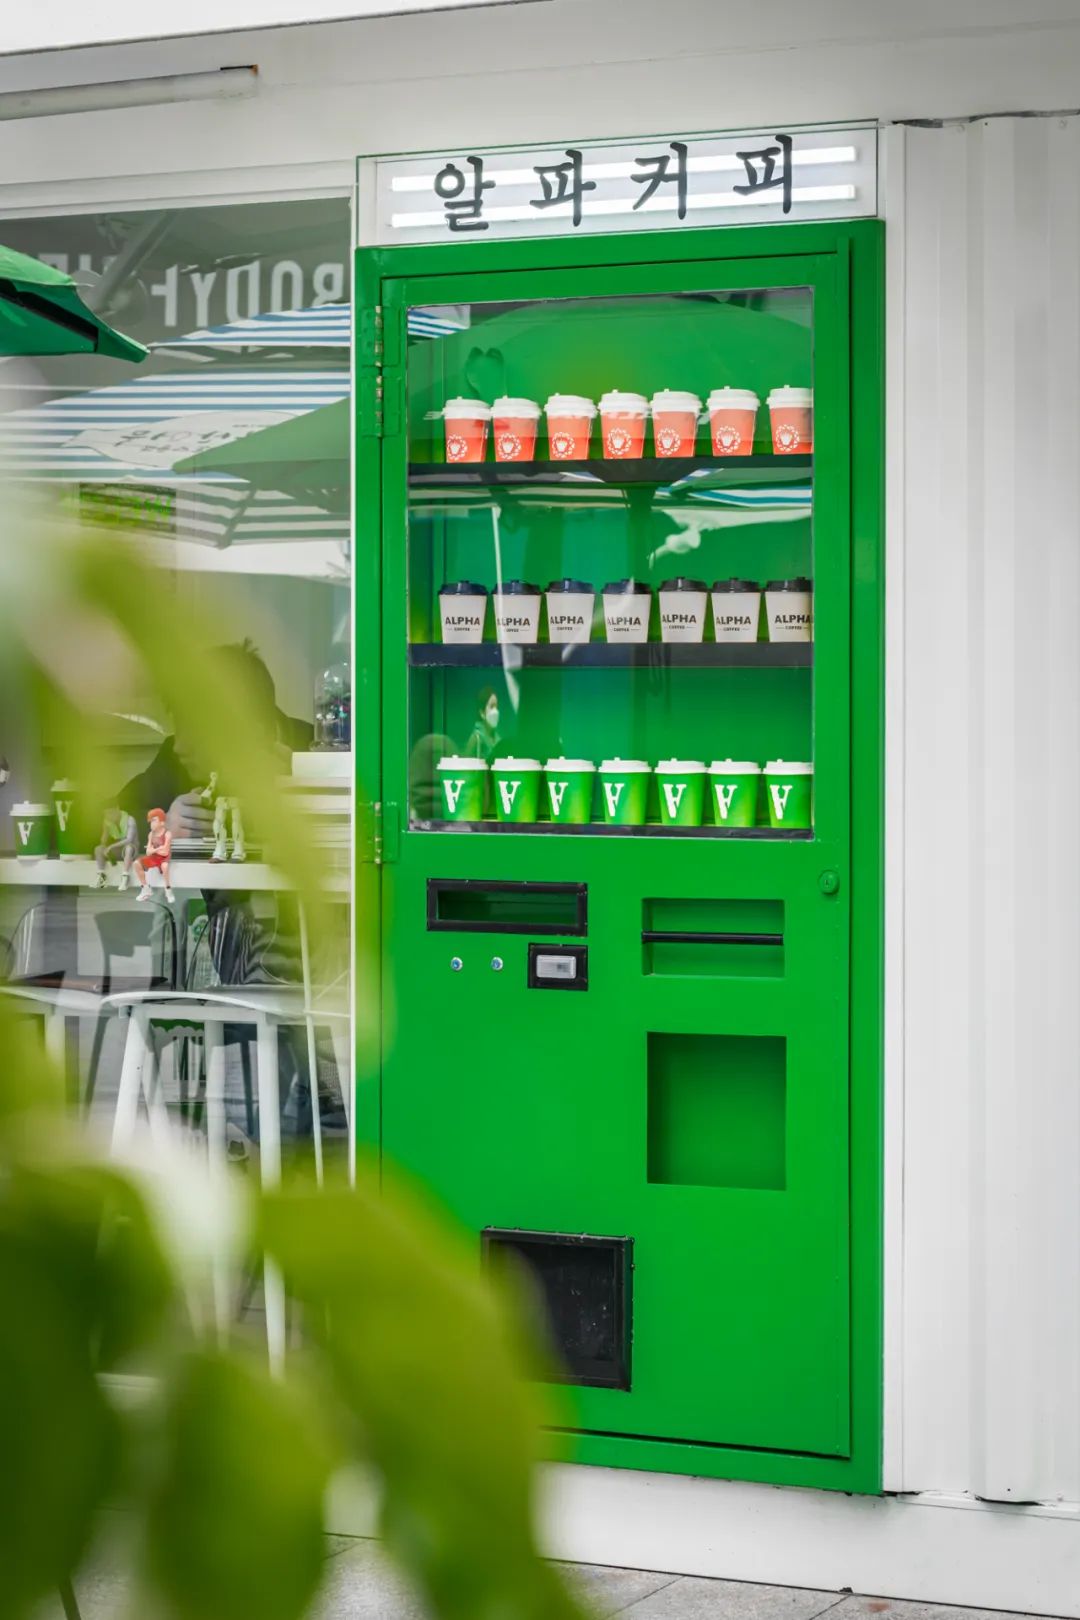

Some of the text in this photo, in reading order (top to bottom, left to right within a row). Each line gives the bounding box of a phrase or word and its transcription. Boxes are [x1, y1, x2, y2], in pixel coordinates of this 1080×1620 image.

[433, 134, 793, 233] 알파커피
[445, 616, 480, 626] ALPHA
[550, 615, 584, 625] ALPHA
[662, 614, 697, 623] ALPHA
[716, 616, 751, 625] ALPHA
